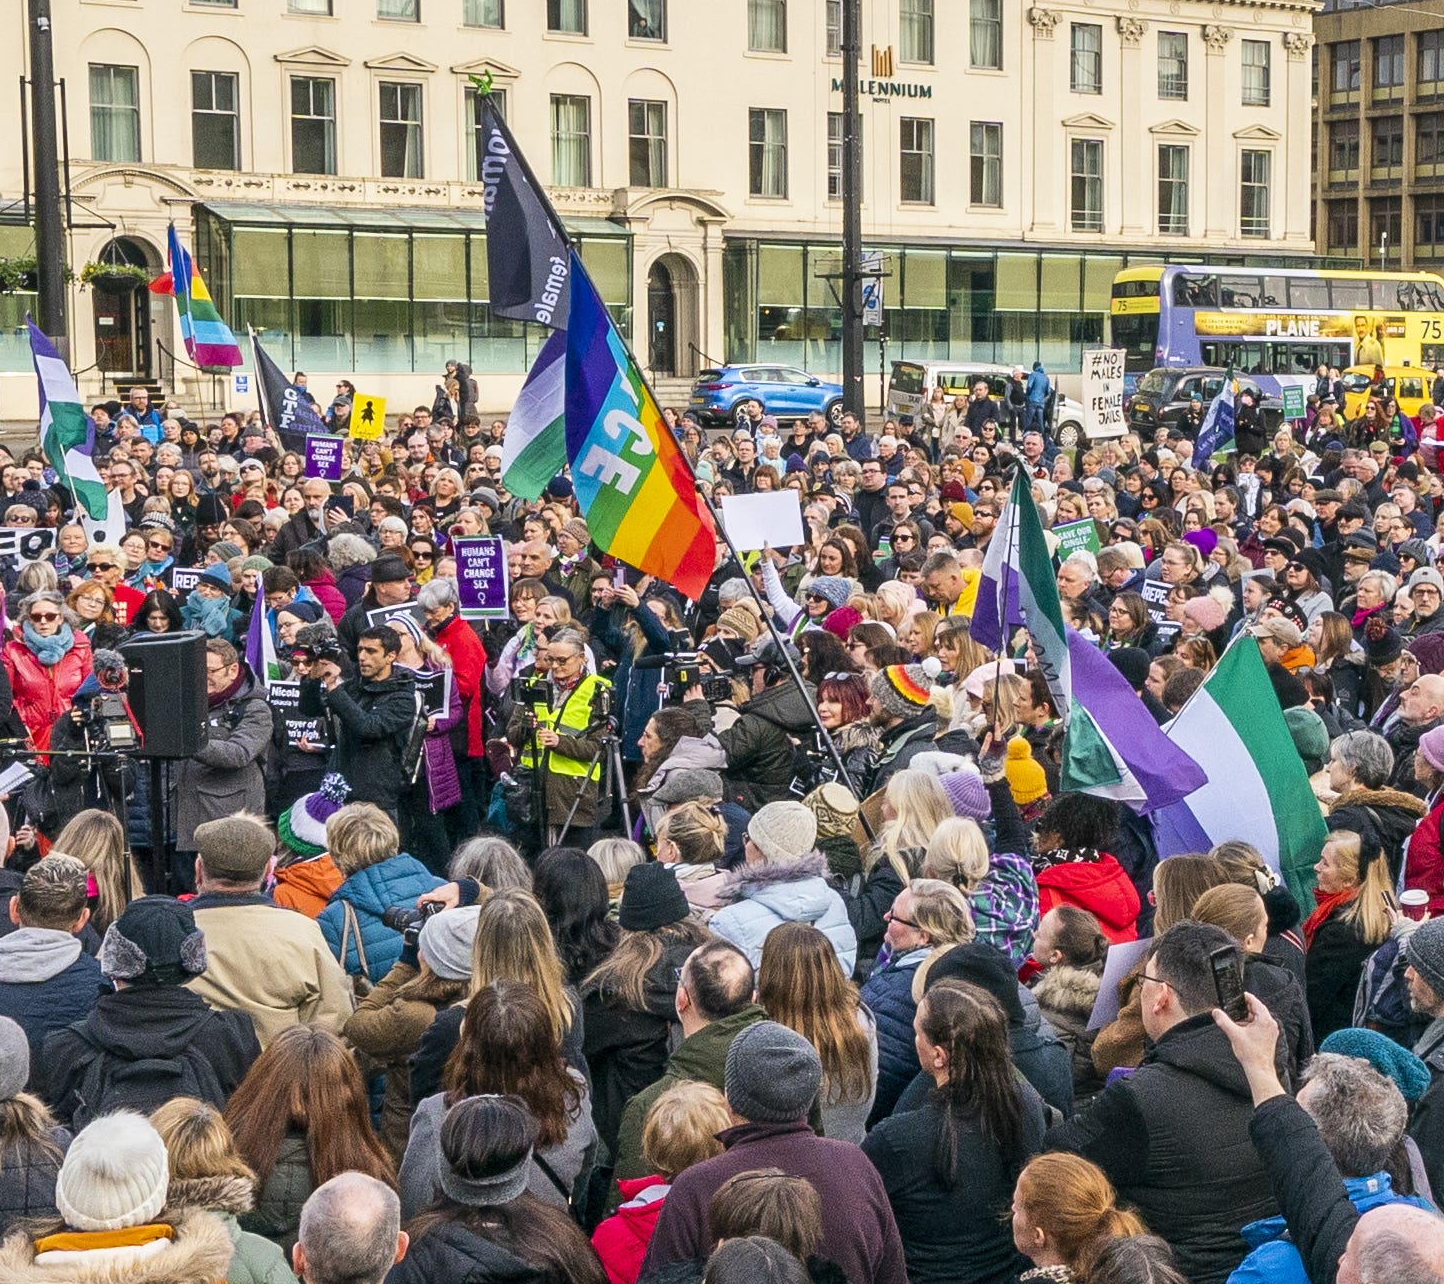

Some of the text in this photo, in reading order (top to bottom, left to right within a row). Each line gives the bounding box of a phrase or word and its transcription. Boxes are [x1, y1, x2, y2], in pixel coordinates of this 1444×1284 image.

[1117, 300, 1128, 312] 75
[1265, 320, 1320, 337] PLANE
[1420, 320, 1441, 339] 75
[1091, 353, 1118, 366] #NO
[1090, 365, 1122, 380] MALES
[1102, 383, 1110, 393] IN
[1092, 395, 1123, 412] FEMALE
[1097, 410, 1122, 425] JAILS
[311, 440, 338, 450] HUMANS
[311, 454, 336, 462] CHANGE
[314, 448, 333, 456] CAN'T
[317, 460, 330, 468] SEX
[1076, 525, 1092, 535] OUR
[461, 546, 496, 557] HUMANS
[467, 557, 490, 567] CAN'T
[463, 567, 496, 579] CHANGE
[175, 575, 199, 589] REP
[472, 579, 490, 590] SEX
[1144, 586, 1168, 605] REPE
[271, 686, 300, 698] Nicola
[286, 719, 317, 729] royer of
